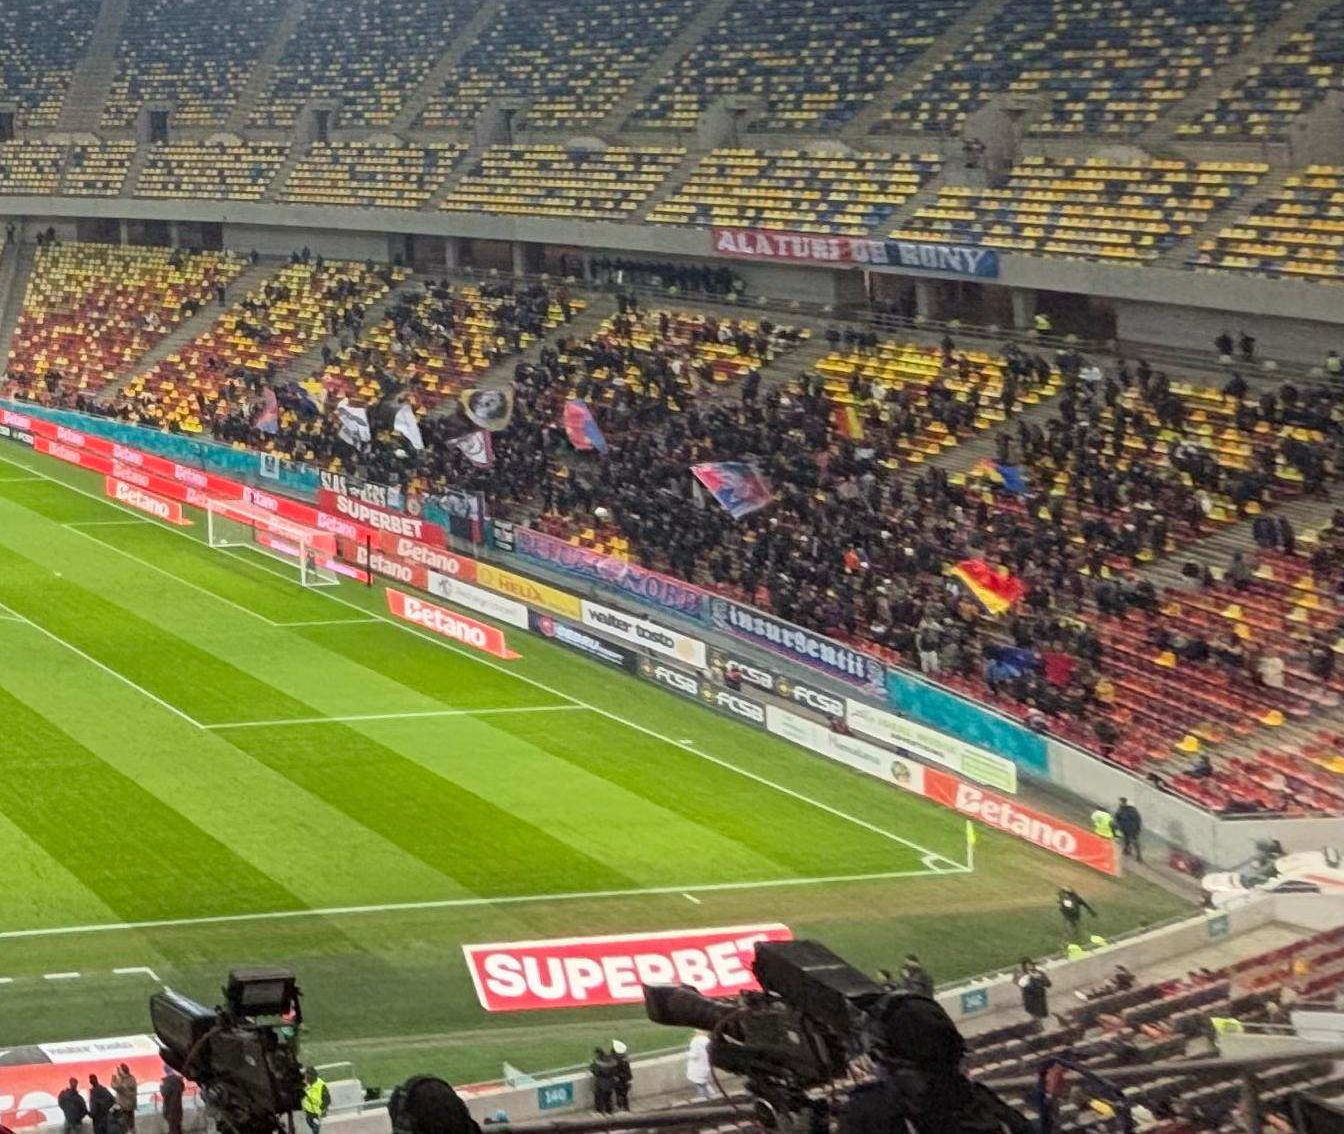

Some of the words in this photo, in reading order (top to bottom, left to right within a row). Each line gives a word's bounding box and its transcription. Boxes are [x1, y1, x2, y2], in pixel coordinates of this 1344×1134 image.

[116, 483, 170, 517] Betano
[336, 494, 423, 539] SUPERBET
[357, 546, 413, 582] Betano
[396, 538, 460, 574] Betano
[403, 595, 487, 649] Betano
[588, 607, 634, 633] walter
[635, 620, 675, 649] tosto
[655, 666, 698, 695] FCSB
[716, 691, 765, 723] FCSB
[793, 685, 845, 716] FCSB
[955, 783, 1078, 854] Betano
